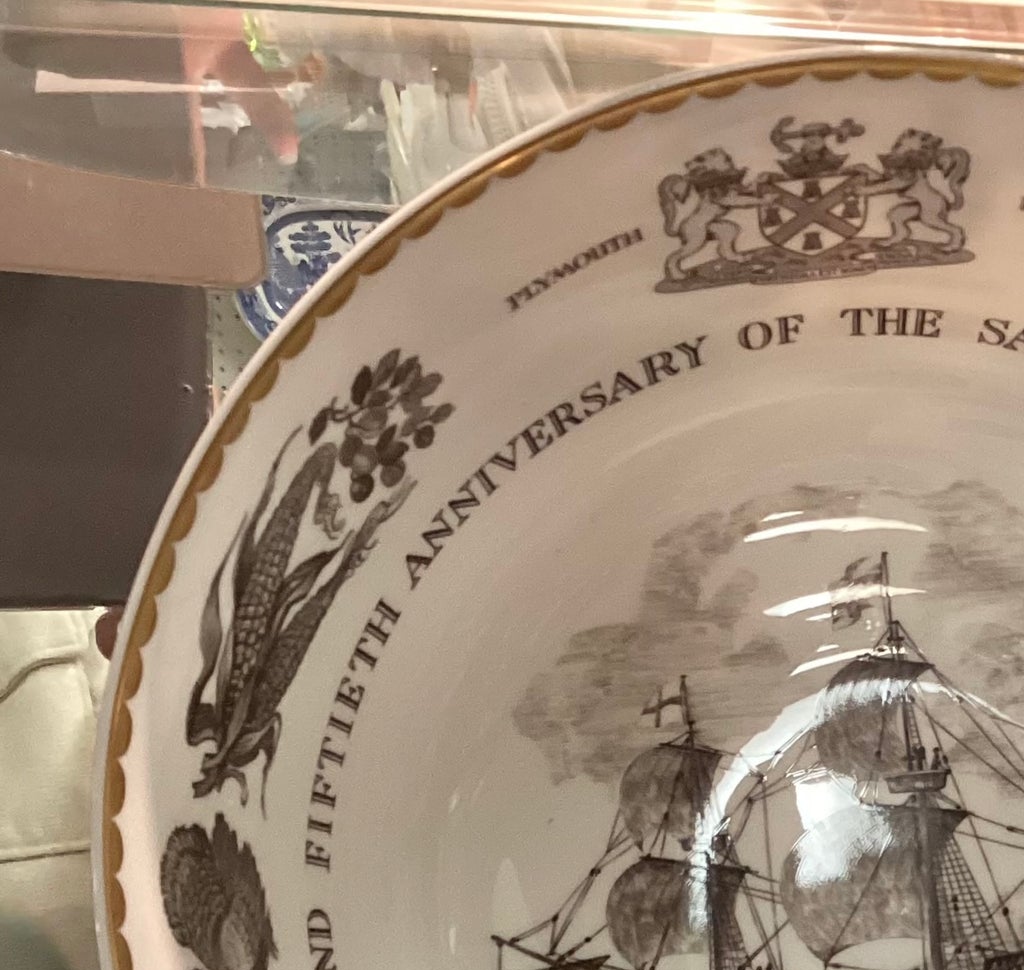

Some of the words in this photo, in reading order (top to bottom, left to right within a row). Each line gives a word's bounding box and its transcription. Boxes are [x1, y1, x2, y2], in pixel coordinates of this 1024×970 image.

[505, 227, 644, 312] PLYMOUTH
[305, 598, 402, 875] FIFTIETH
[404, 335, 708, 591] ANNIVERSARY
[737, 315, 805, 353] OF
[841, 307, 945, 339] THE
